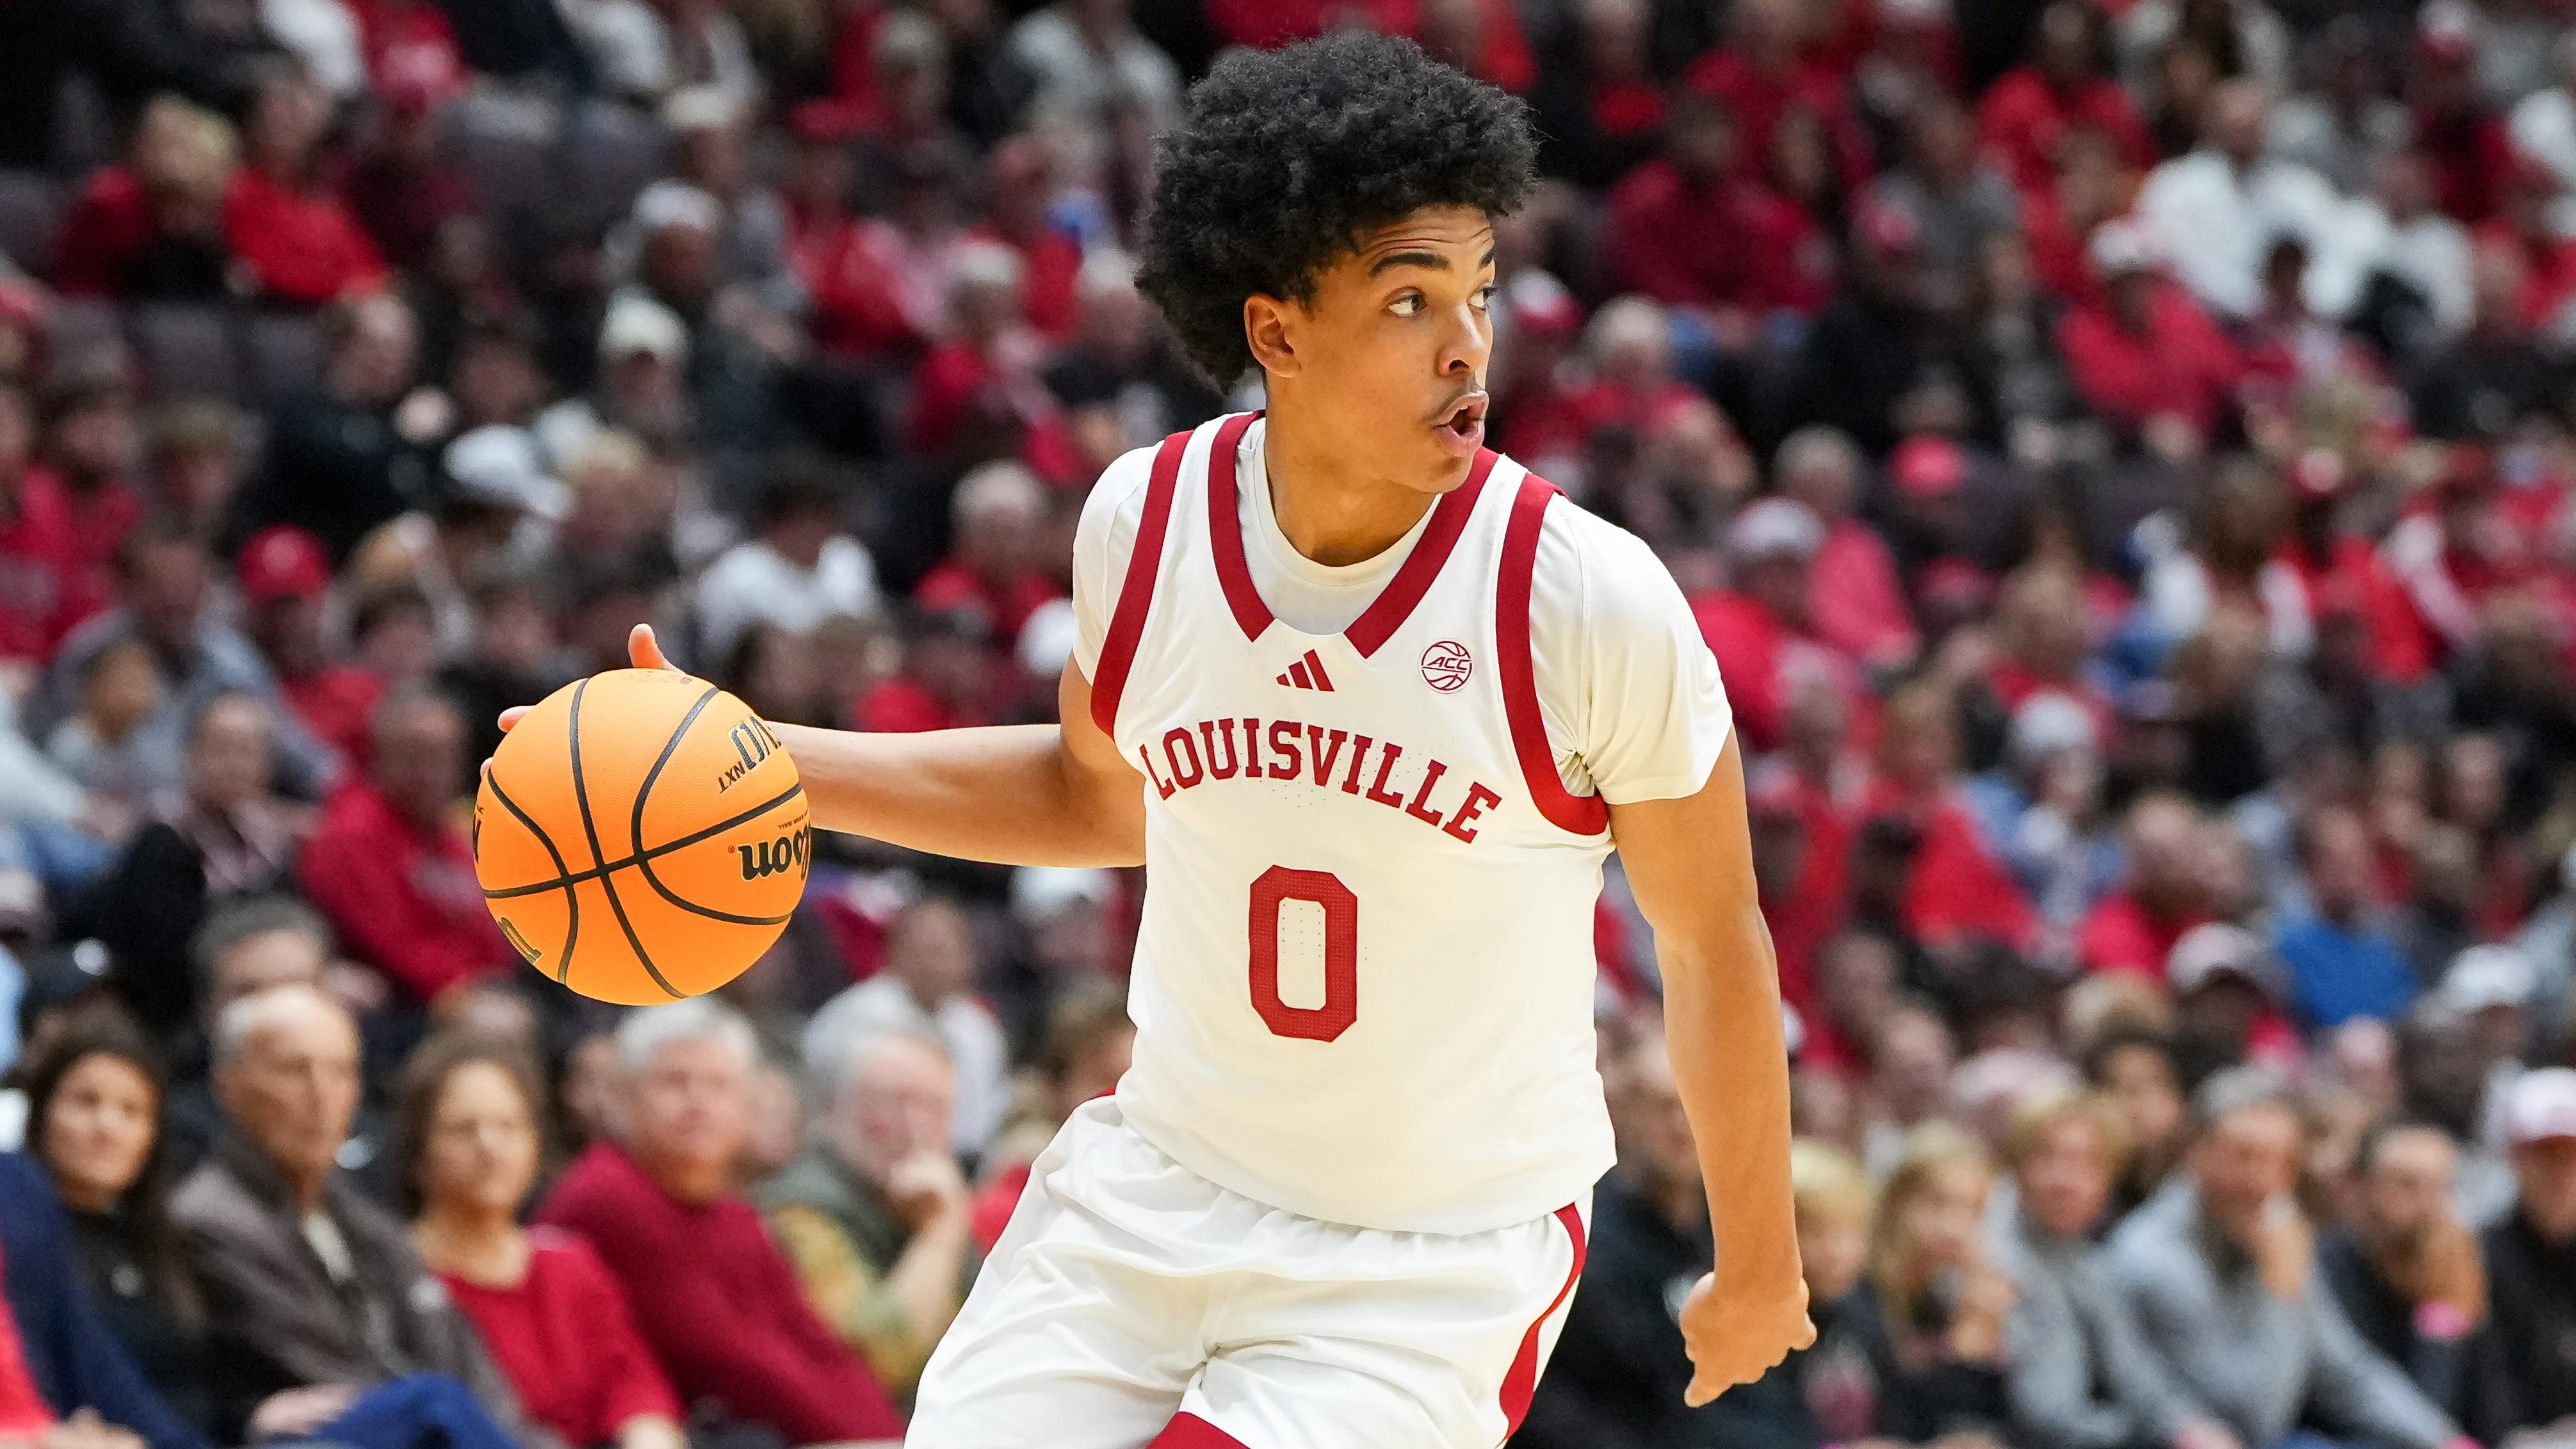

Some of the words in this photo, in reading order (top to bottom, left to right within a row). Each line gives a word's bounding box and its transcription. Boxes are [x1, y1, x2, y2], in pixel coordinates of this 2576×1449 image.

[1427, 656, 1471, 670] ACC
[729, 715, 782, 770] VO
[718, 761, 745, 794] NXT
[1140, 718, 1502, 844] LOUISVILLE
[1249, 864, 1357, 1042] 0
